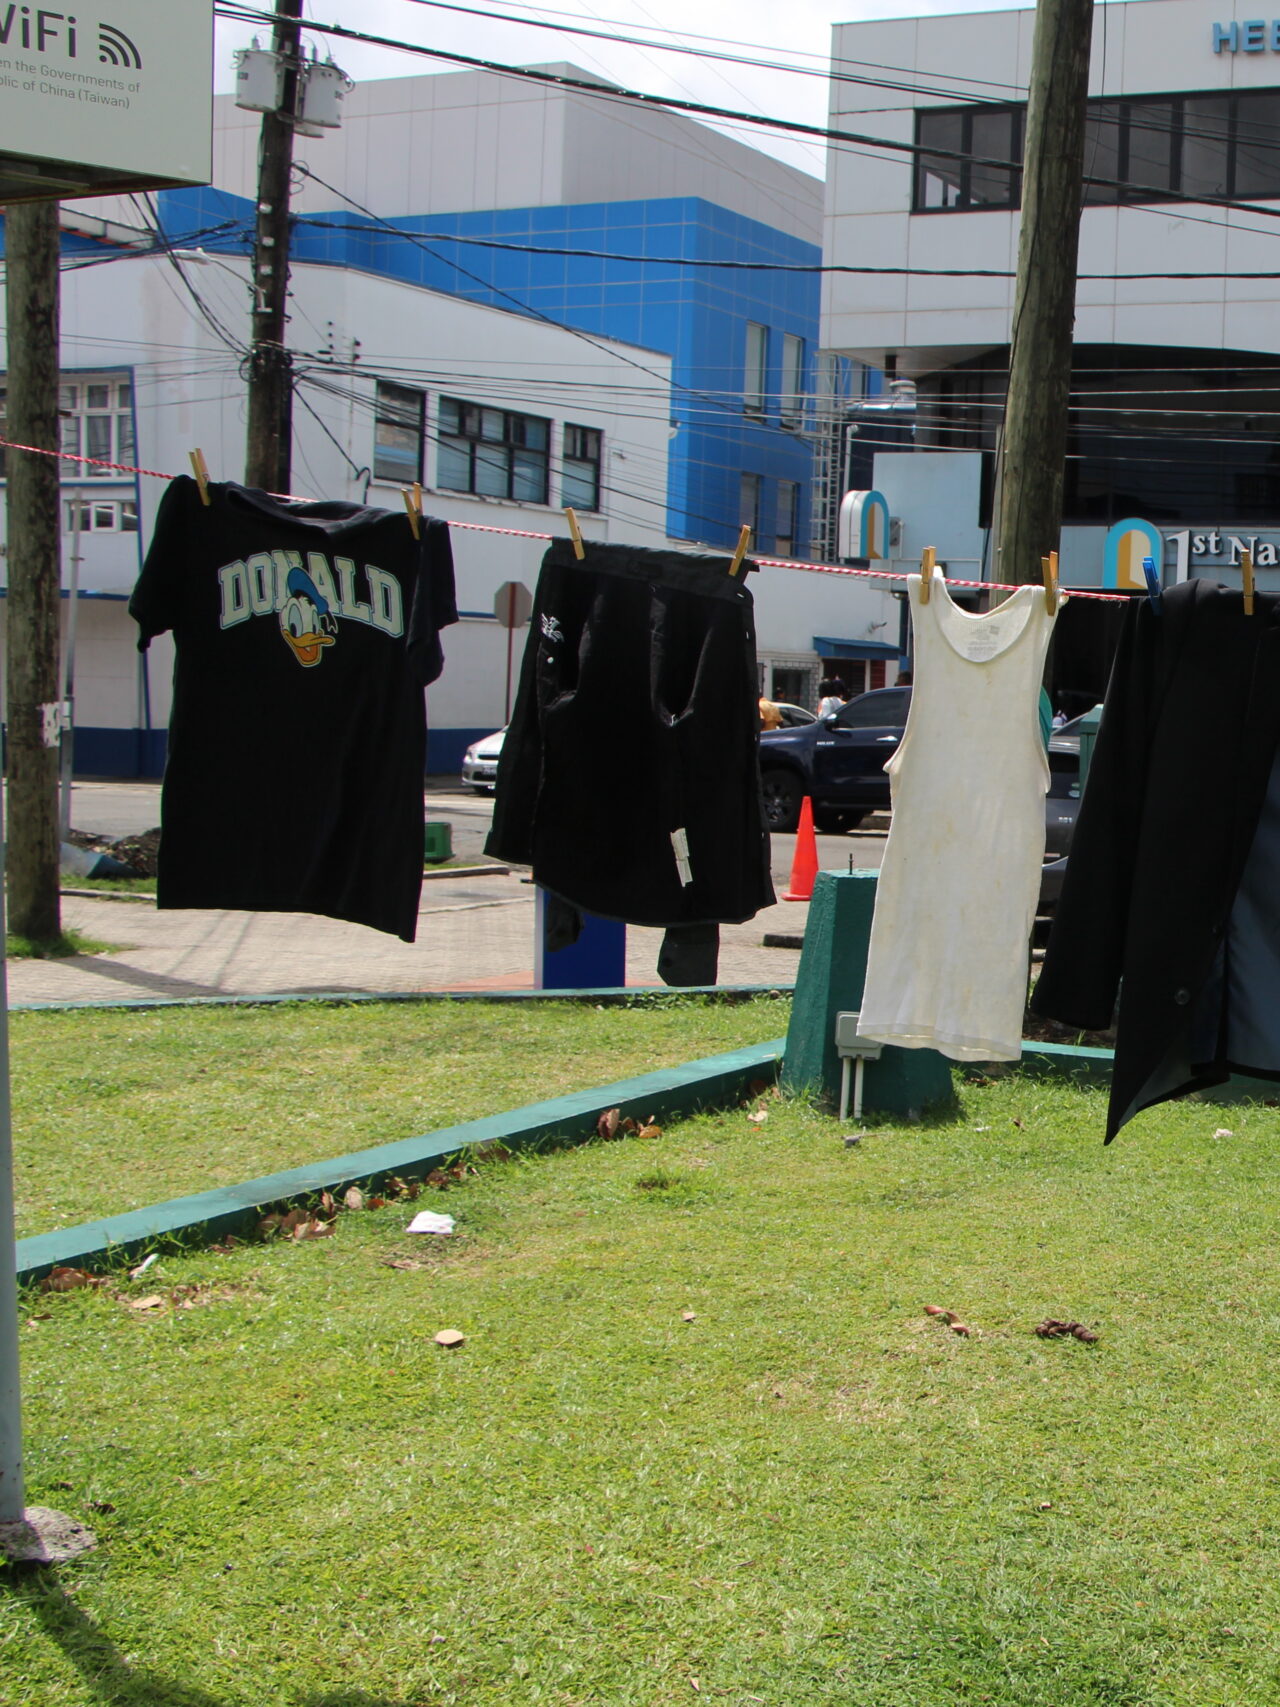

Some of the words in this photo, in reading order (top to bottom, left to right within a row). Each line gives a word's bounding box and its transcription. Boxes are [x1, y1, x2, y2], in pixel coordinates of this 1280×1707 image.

[16, 60, 37, 74] the
[40, 64, 125, 90] Governments
[128, 82, 141, 93] of
[23, 81, 36, 91] of
[40, 82, 75, 99] China
[78, 89, 130, 110] (Taiwan)
[218, 549, 404, 639] DONALD
